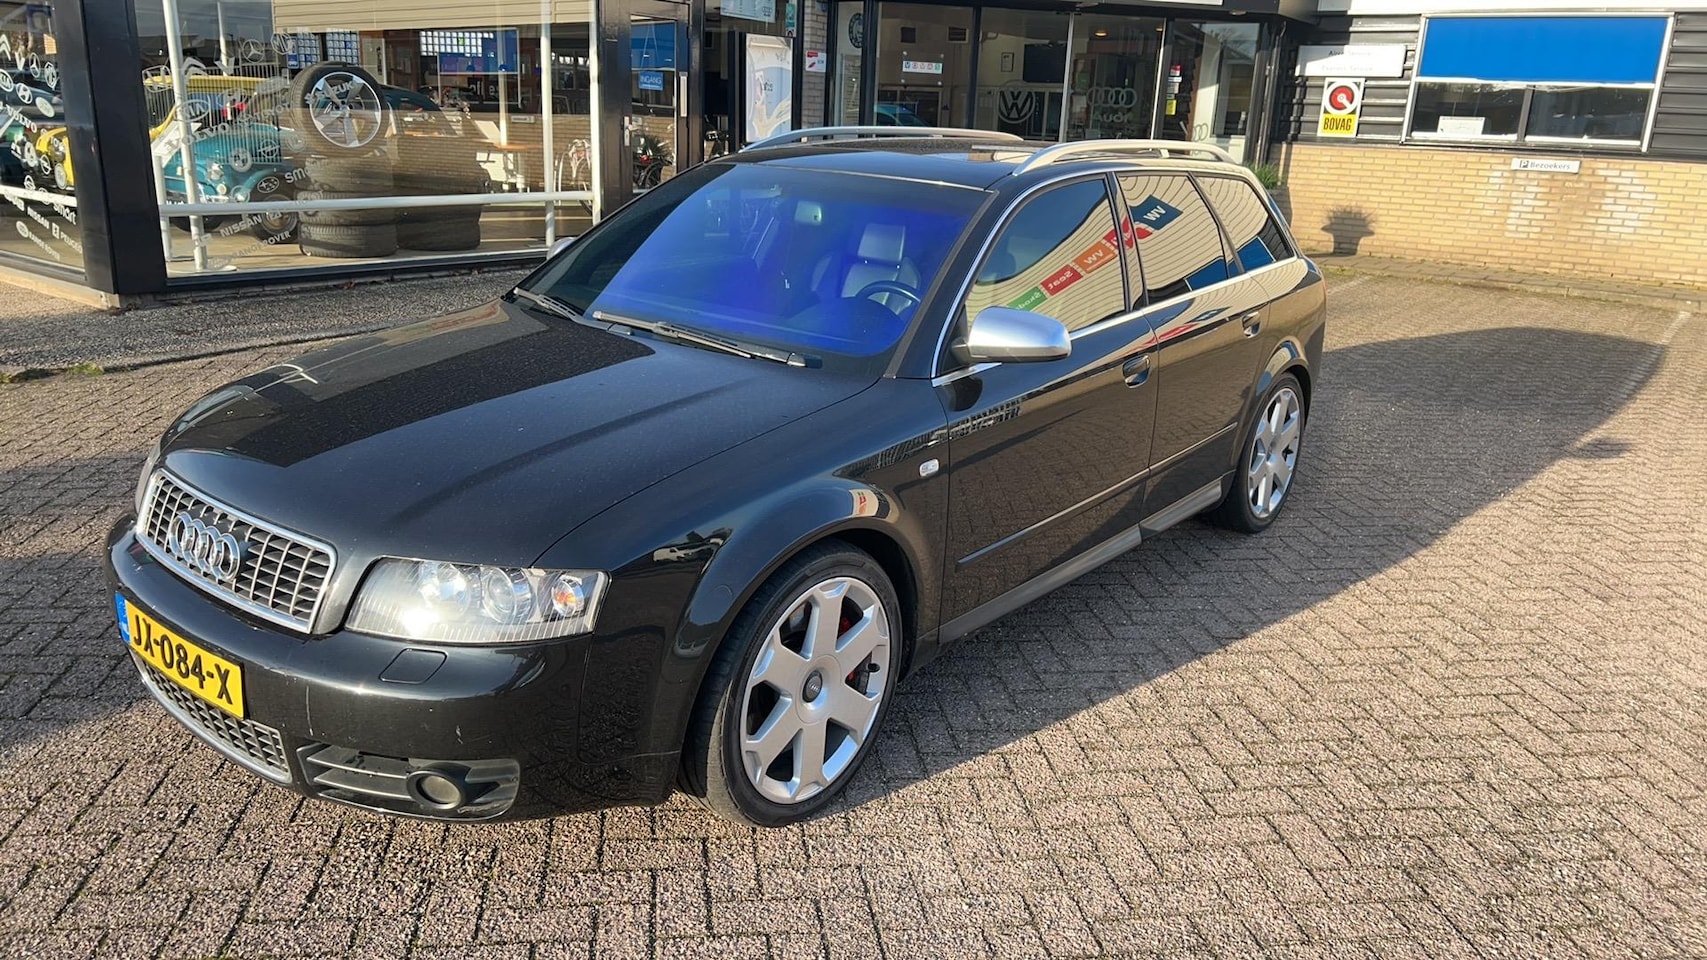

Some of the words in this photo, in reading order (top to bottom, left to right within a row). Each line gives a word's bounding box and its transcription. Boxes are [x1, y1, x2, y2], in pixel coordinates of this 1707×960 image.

[5, 104, 37, 133] VOLVO
[1092, 111, 1128, 123] Audi
[1323, 117, 1352, 131] BOVAG
[164, 122, 229, 149] VOLVO
[1530, 161, 1571, 171] Bezoekers
[26, 206, 50, 229] NISSAN
[219, 214, 263, 238] NISSAN
[262, 231, 291, 246] ROVER
[133, 614, 233, 705] JX-084-X
